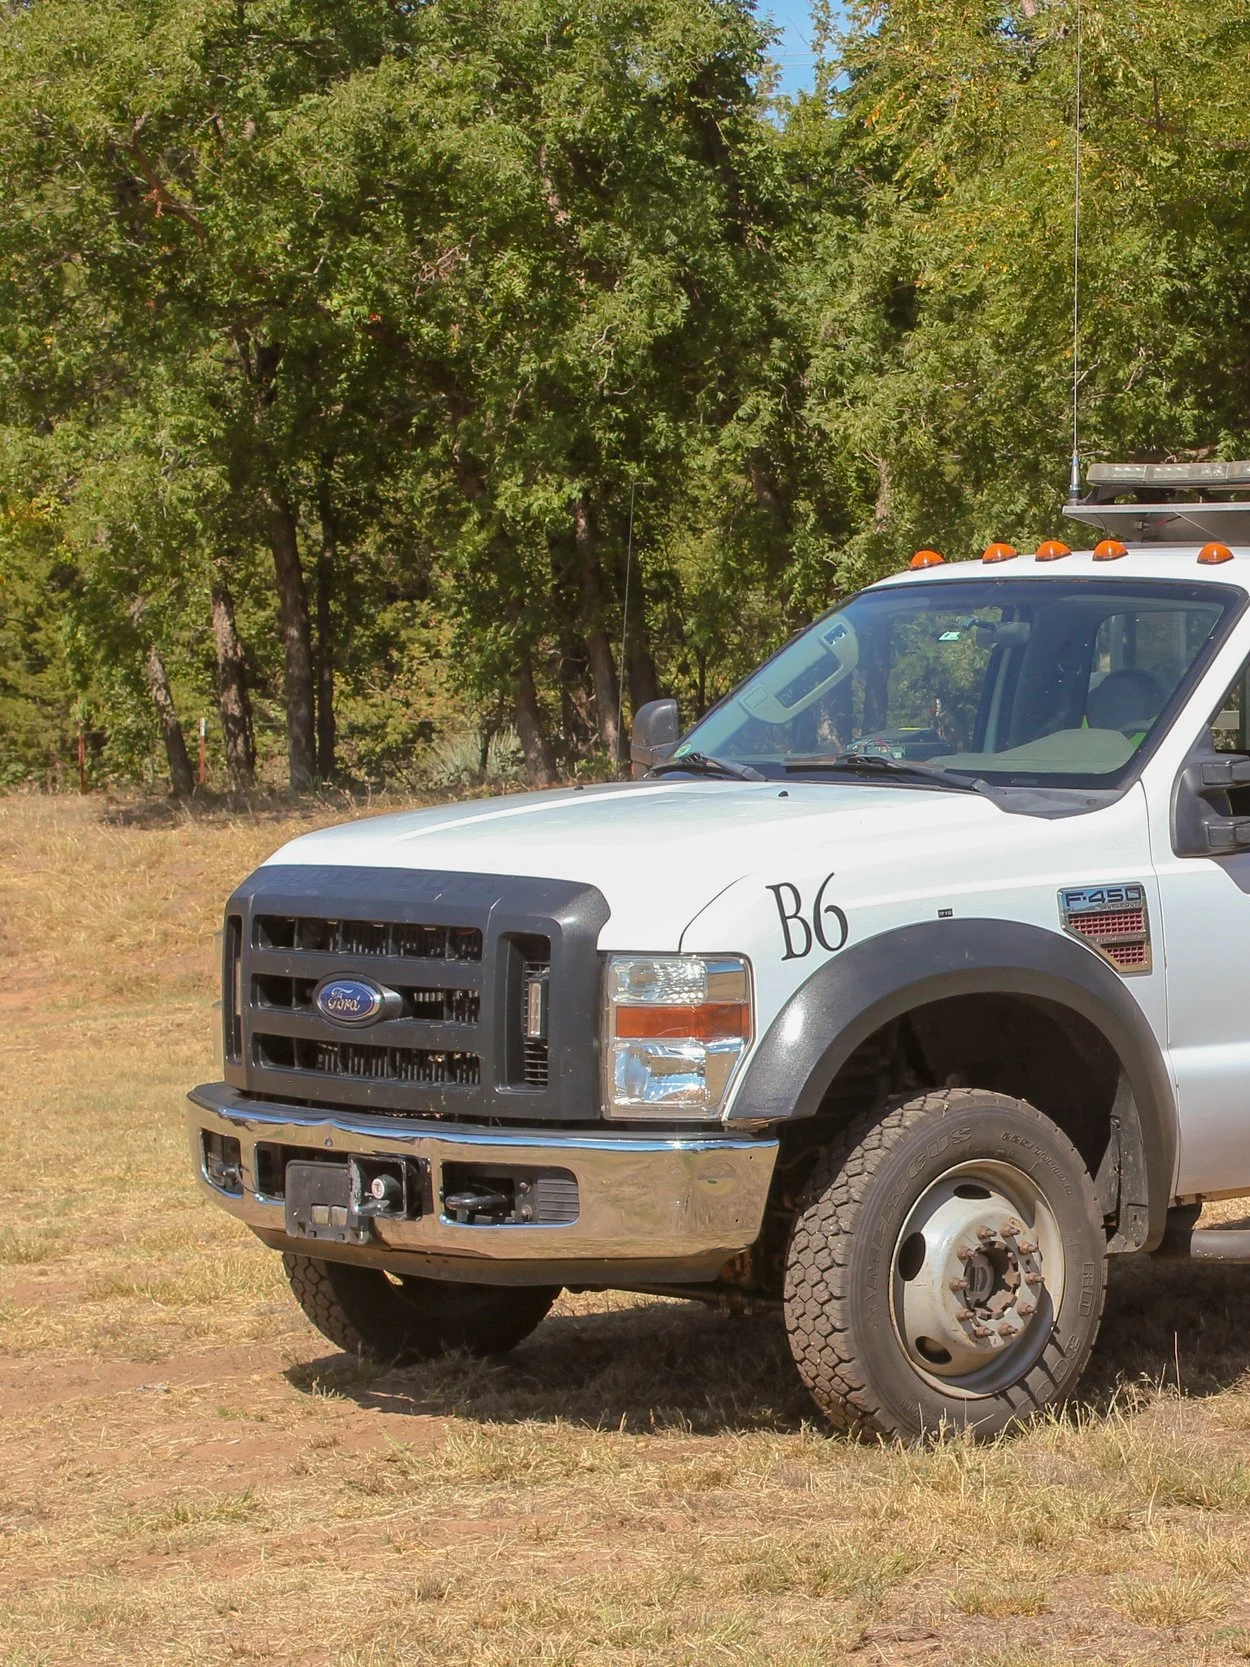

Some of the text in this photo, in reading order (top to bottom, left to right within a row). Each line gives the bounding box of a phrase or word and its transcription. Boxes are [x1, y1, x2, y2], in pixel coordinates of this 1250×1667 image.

[1065, 887, 1142, 907] F-450
[765, 872, 848, 961] B6
[328, 987, 361, 1011] Ford
